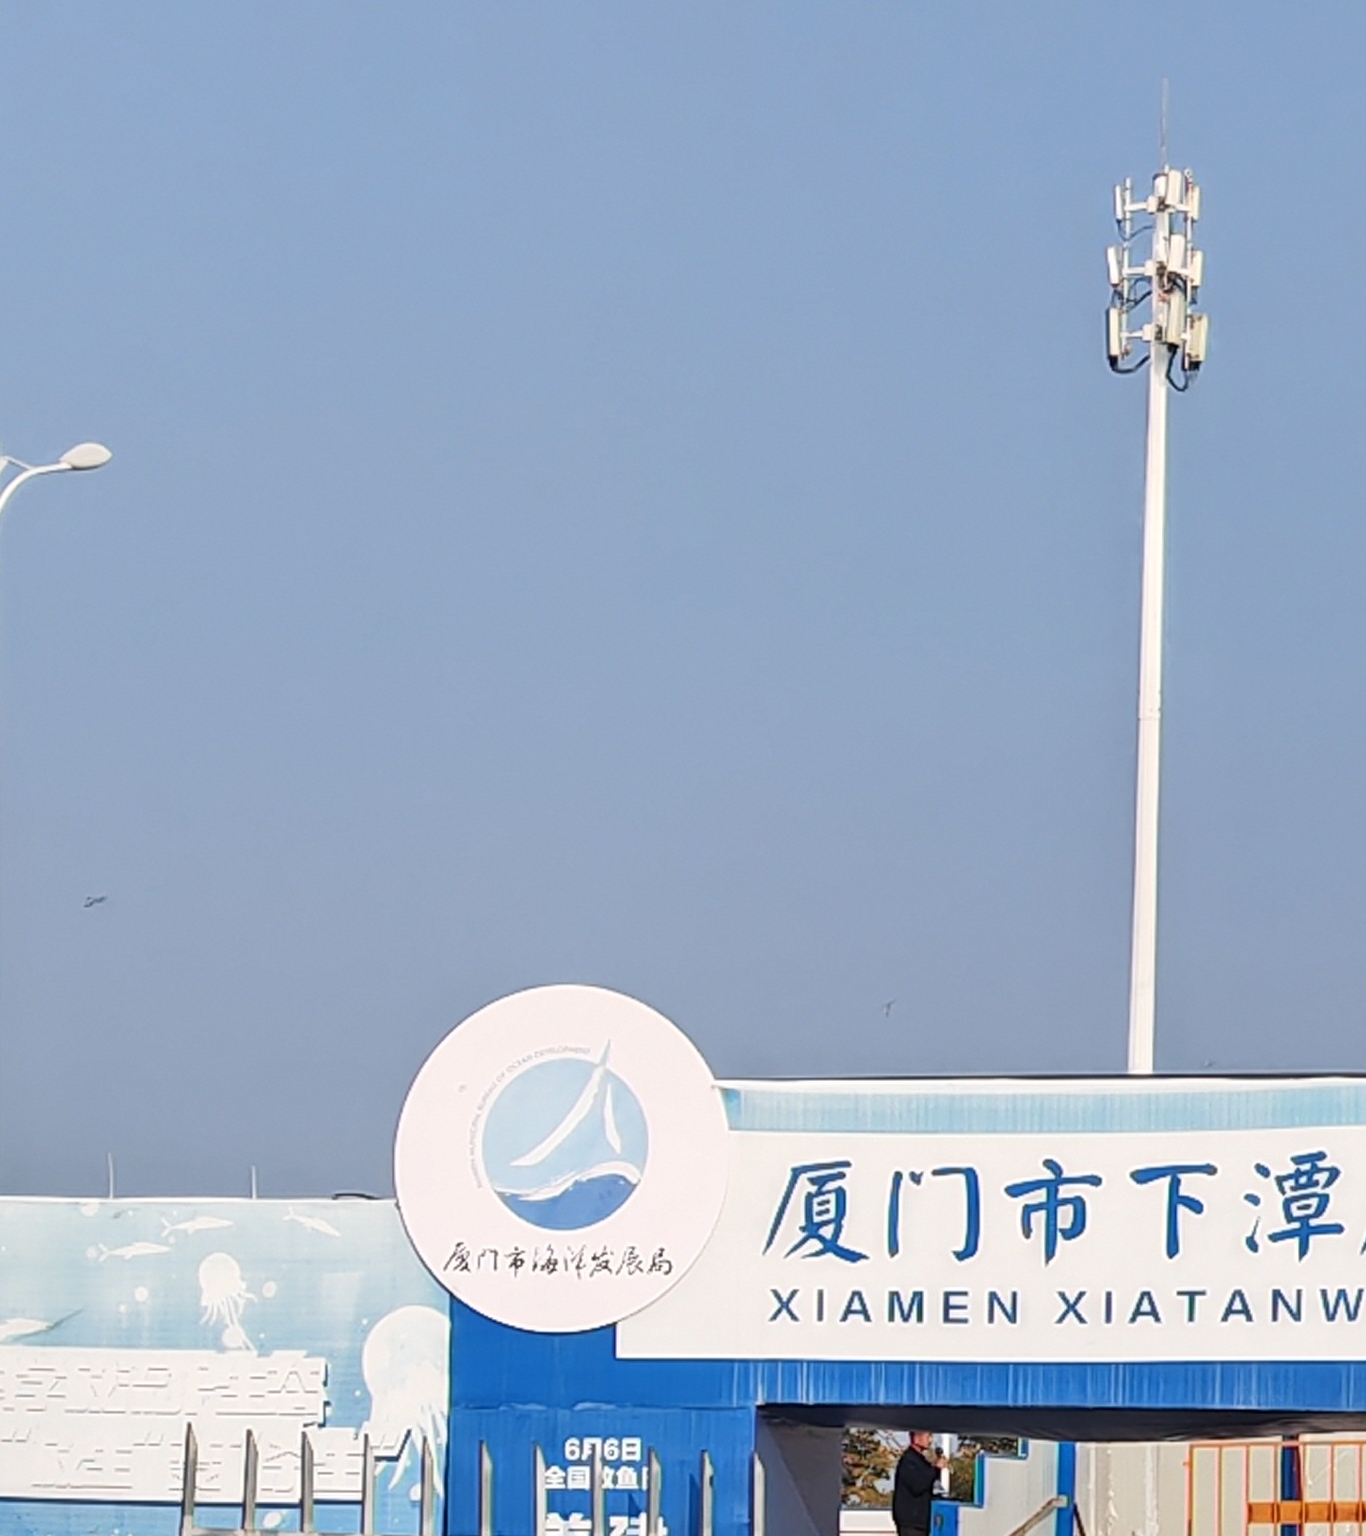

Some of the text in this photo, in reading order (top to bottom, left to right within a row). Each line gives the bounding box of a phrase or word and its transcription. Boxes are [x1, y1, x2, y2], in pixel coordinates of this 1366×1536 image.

[443, 1241, 674, 1279] 厦门市海洋发展局
[769, 1289, 1019, 1326] XIAMEN
[564, 1437, 642, 1462] 6月6日
[543, 1465, 650, 1491] 全国放鱼
